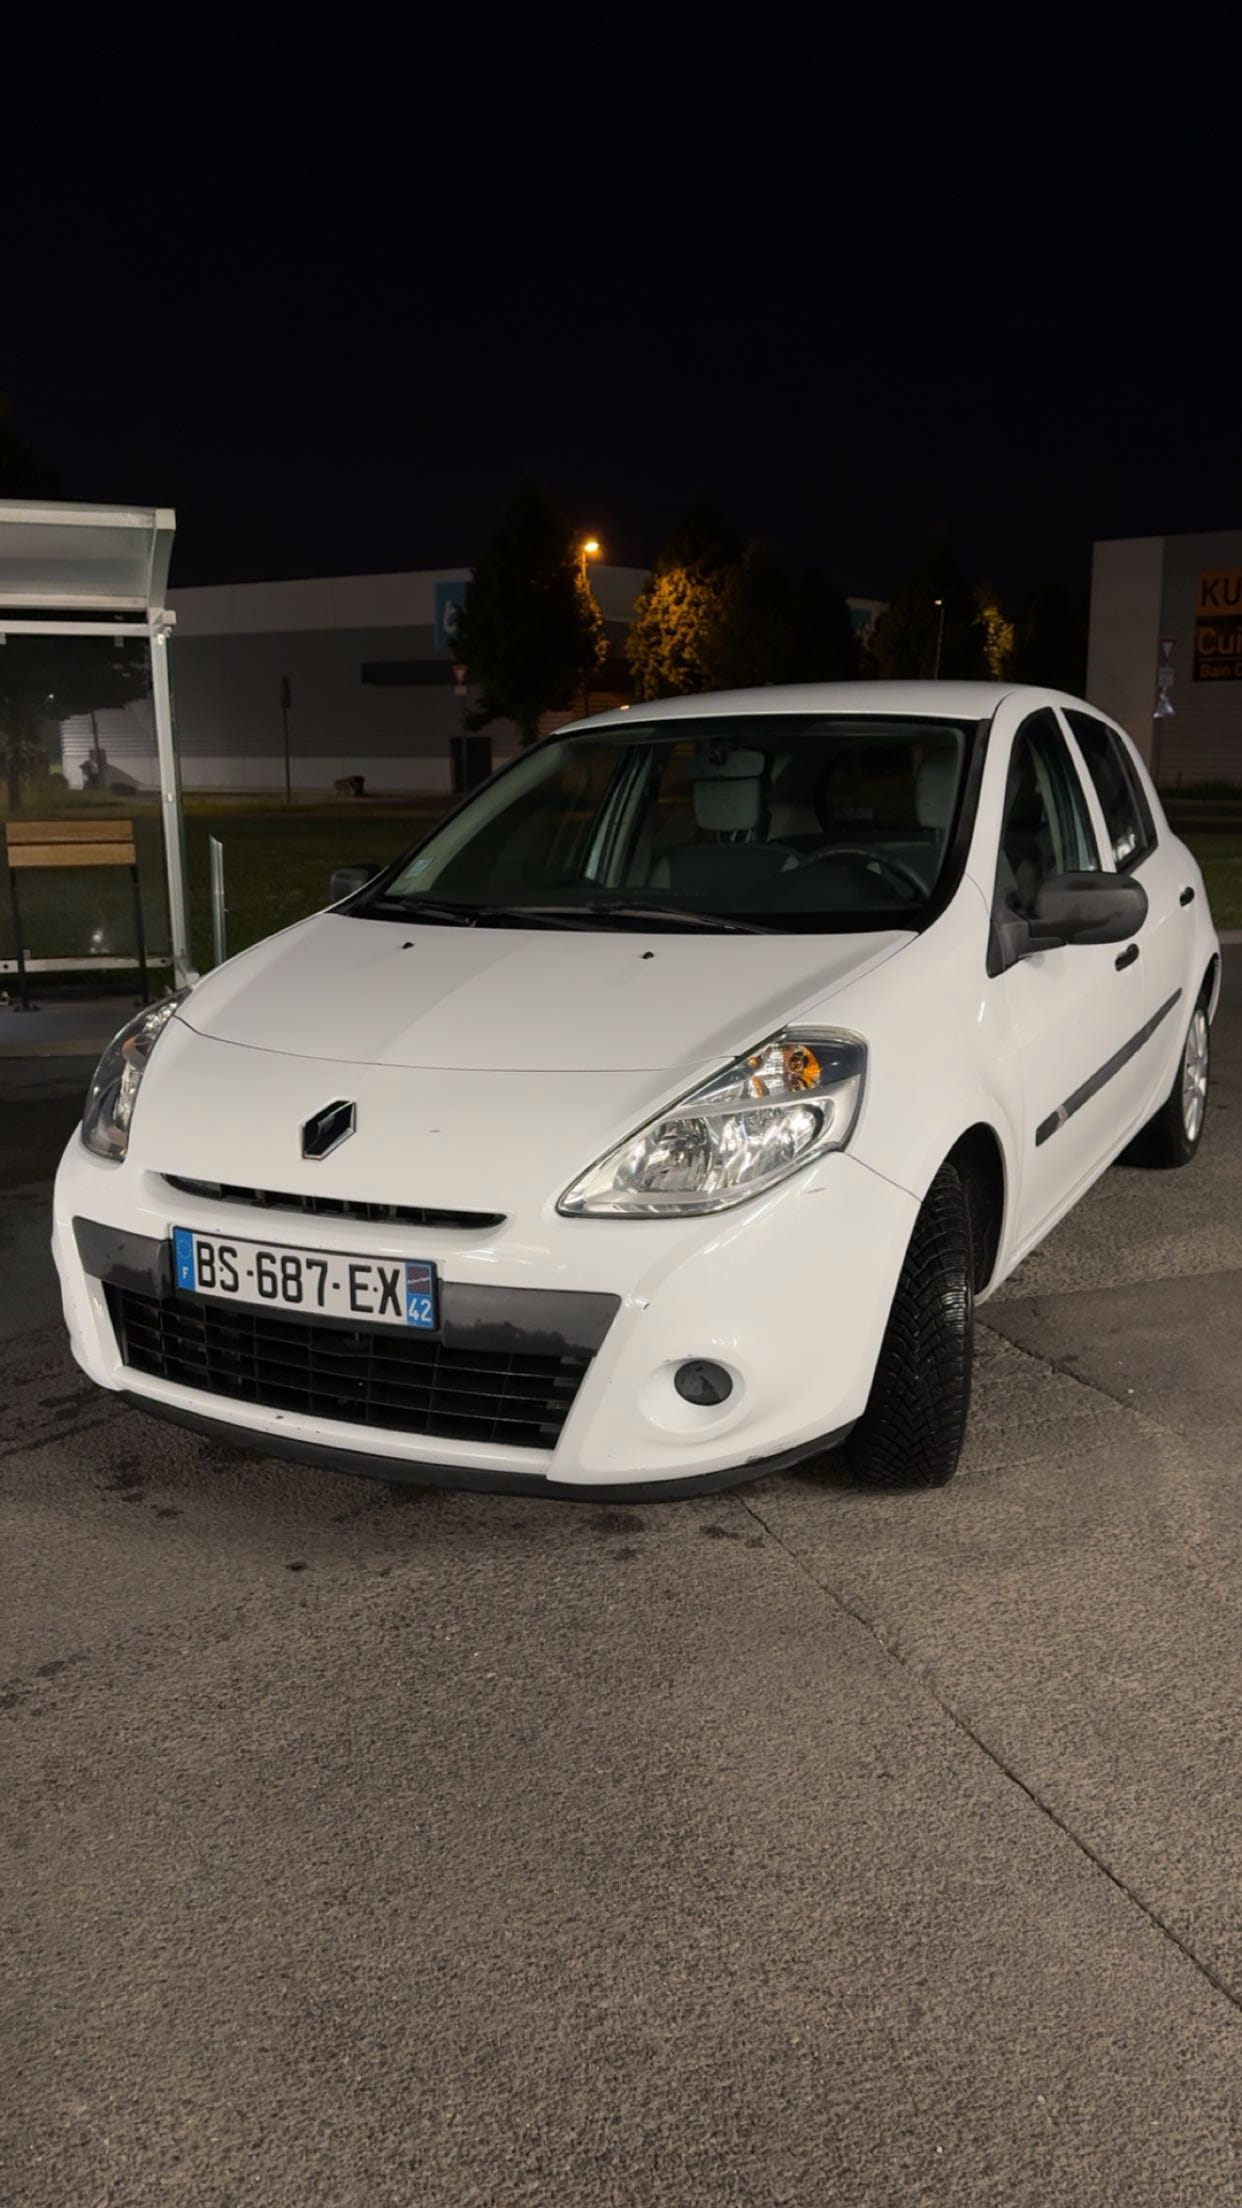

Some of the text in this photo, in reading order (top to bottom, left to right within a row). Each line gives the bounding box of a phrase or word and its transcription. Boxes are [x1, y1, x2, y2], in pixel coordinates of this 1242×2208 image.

[1201, 577, 1242, 606] KU
[181, 1266, 189, 1280] F
[196, 1240, 402, 1317] BS-687-EX
[408, 1298, 432, 1322] 42
